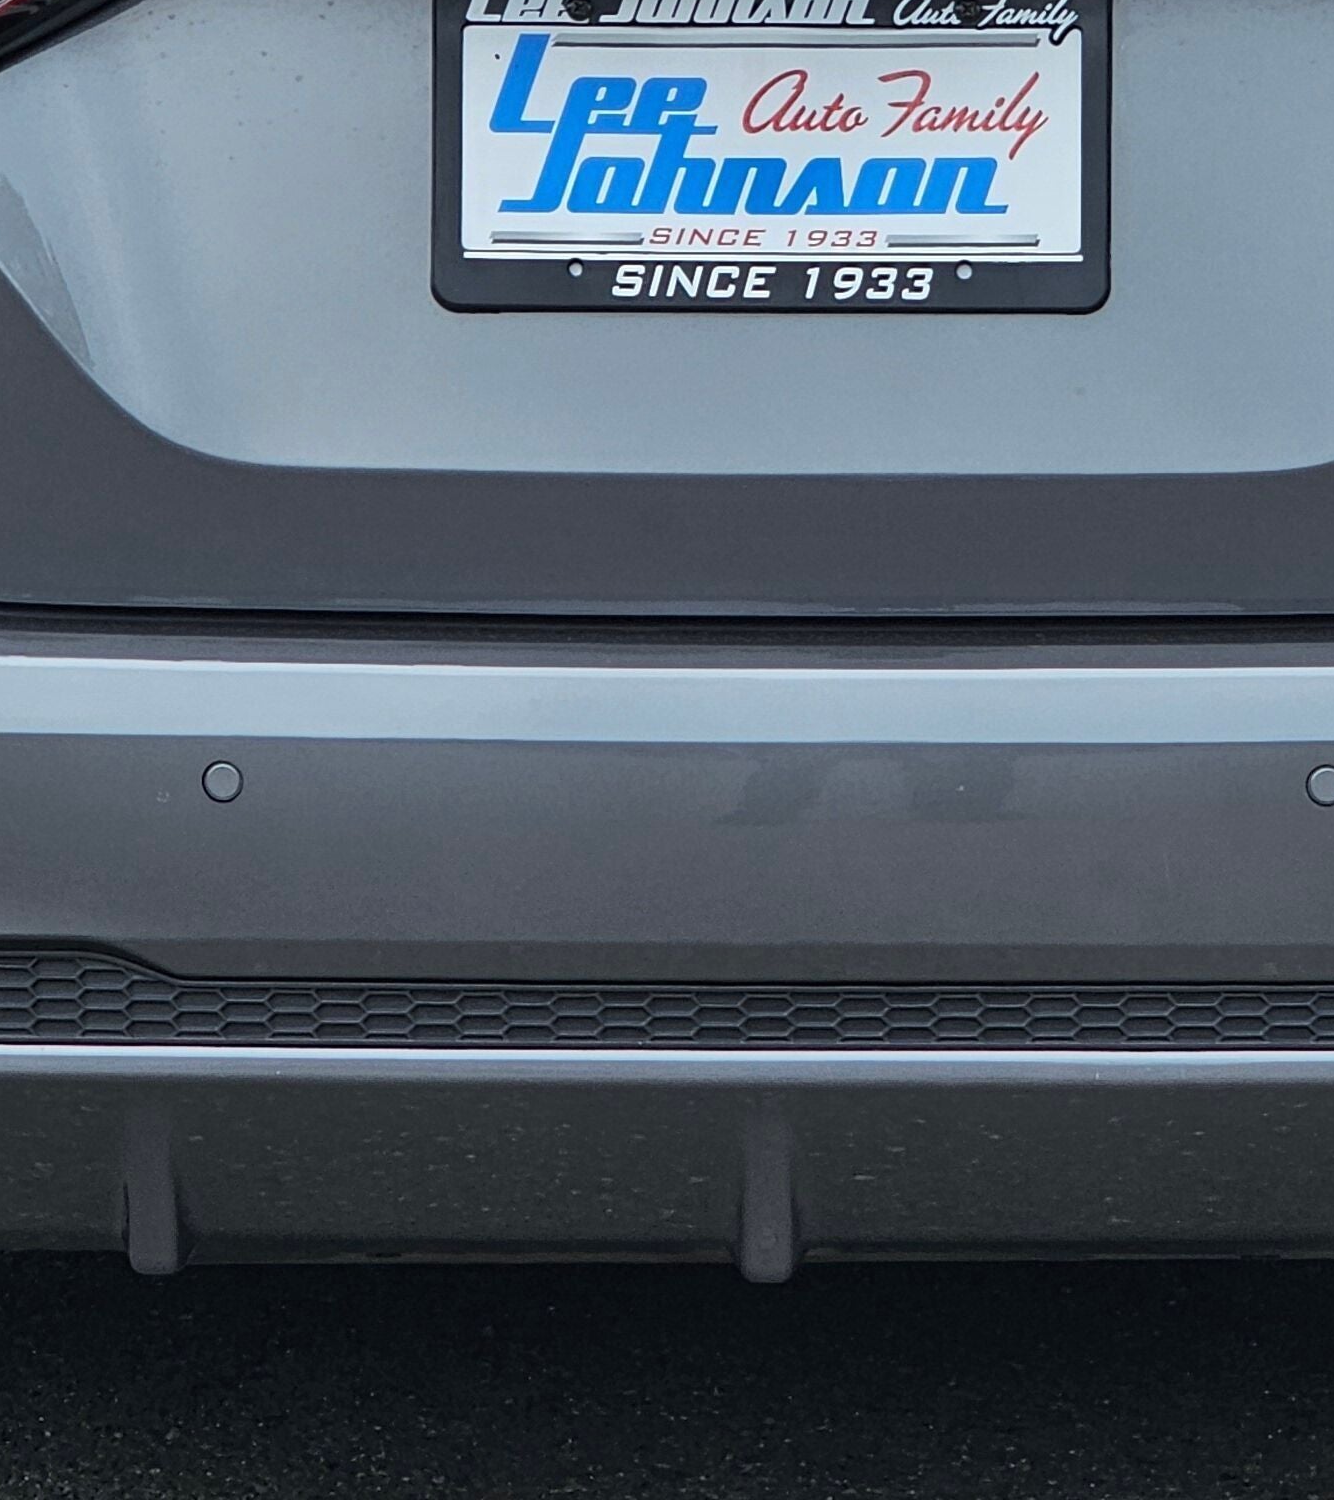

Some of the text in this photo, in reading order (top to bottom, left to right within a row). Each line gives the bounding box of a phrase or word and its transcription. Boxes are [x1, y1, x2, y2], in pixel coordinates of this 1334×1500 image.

[489, 33, 1049, 160] Lee Auto Family
[497, 128, 1009, 216] Johnson
[649, 227, 879, 248] SINCE 1933
[612, 264, 934, 300] SINCE 1933
